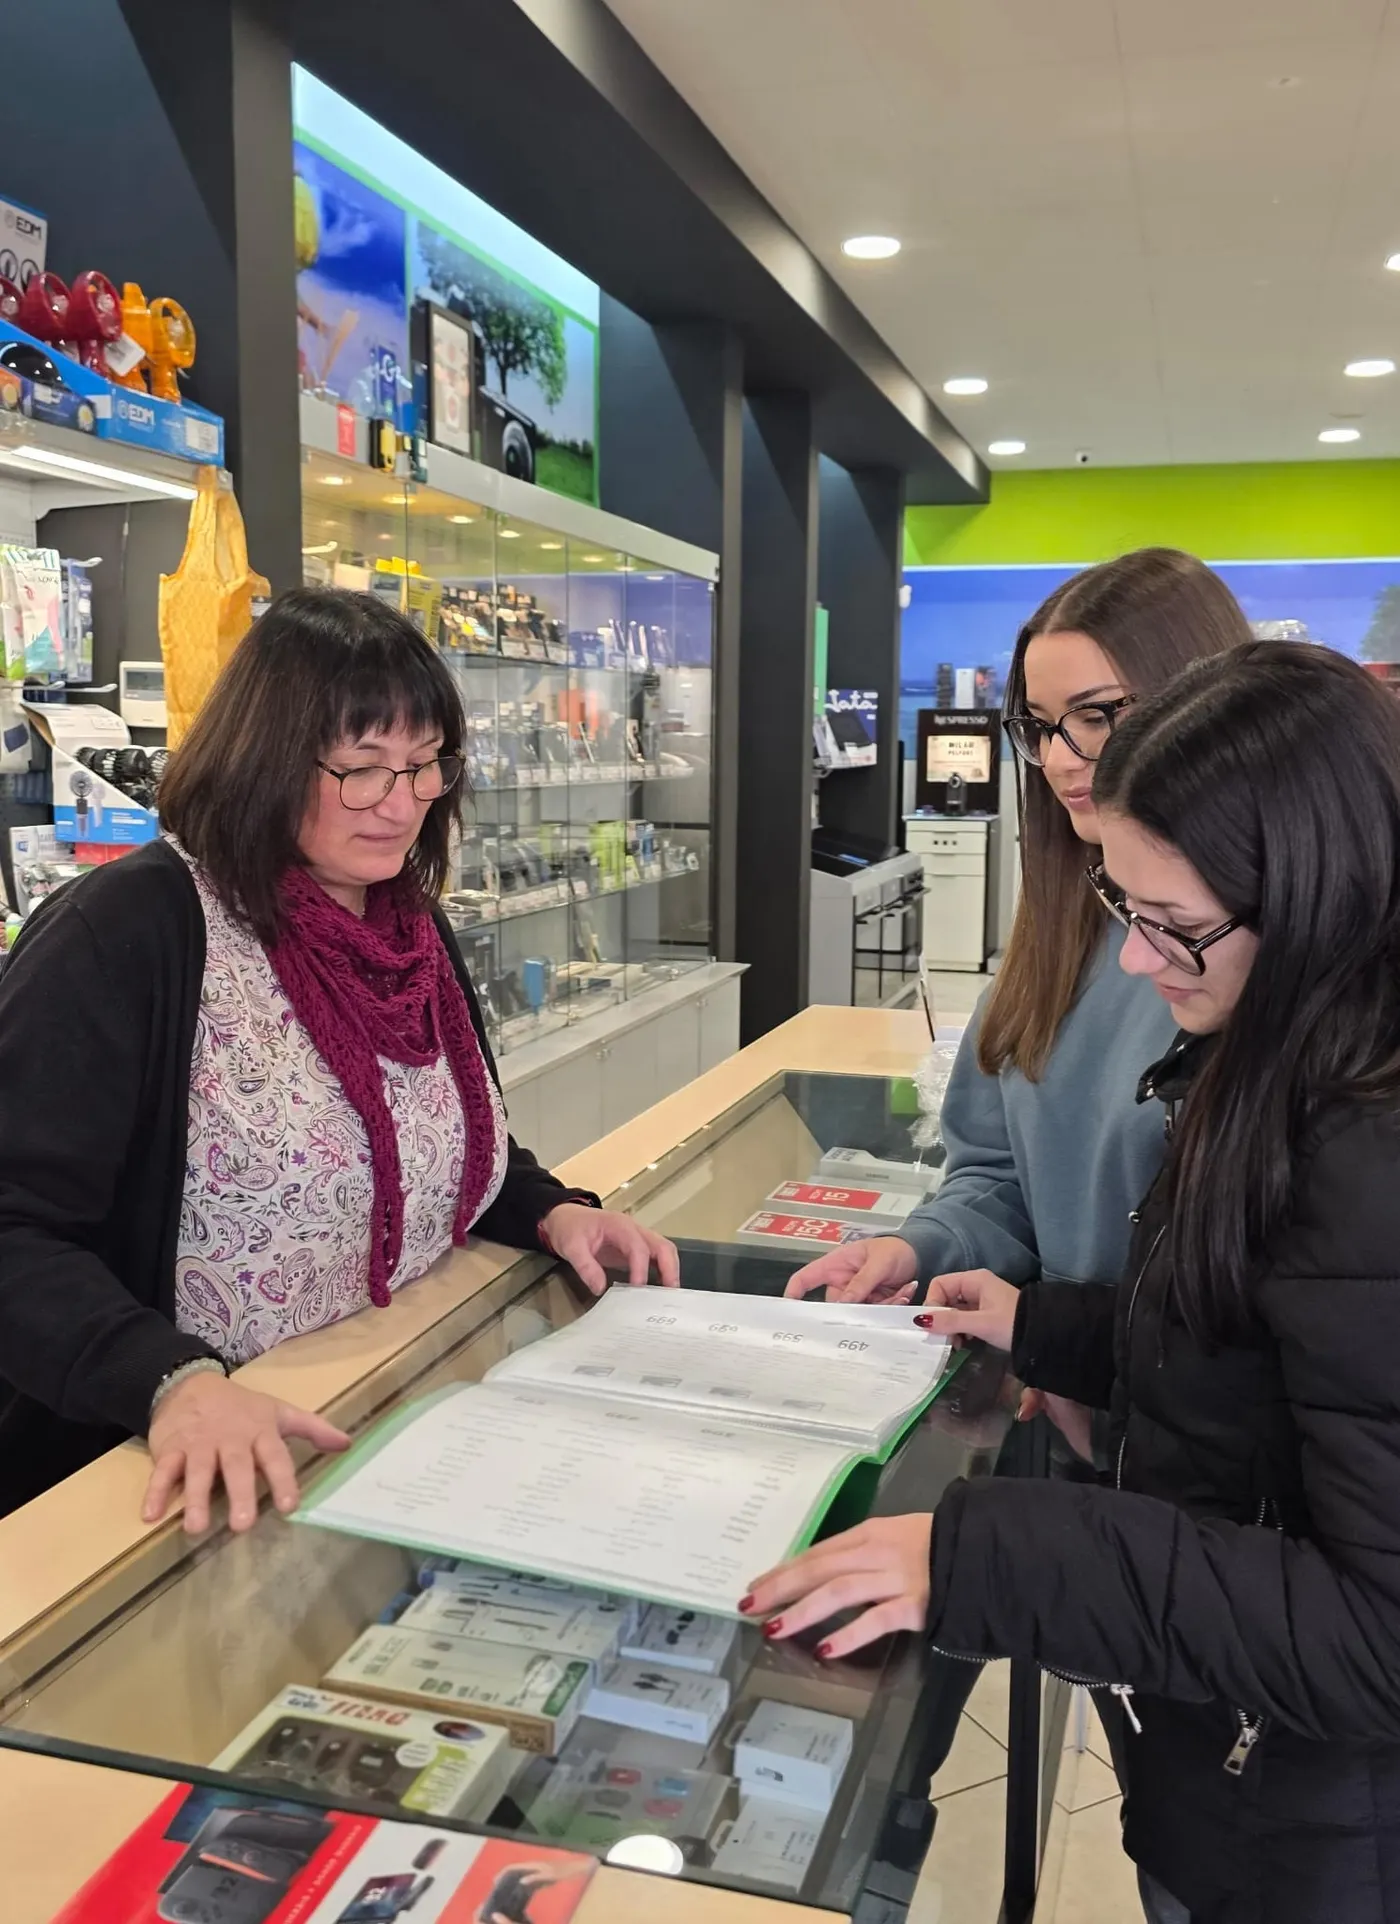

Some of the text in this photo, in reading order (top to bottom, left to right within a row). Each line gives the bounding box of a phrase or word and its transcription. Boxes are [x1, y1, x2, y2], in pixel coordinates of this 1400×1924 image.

[128, 404, 156, 426] EDM
[823, 689, 878, 713] Jata
[934, 714, 988, 726] NESPRESSO
[822, 1191, 850, 1202] 15
[793, 1220, 829, 1238] 15C
[772, 1331, 804, 1344] 599
[837, 1339, 869, 1352] 499
